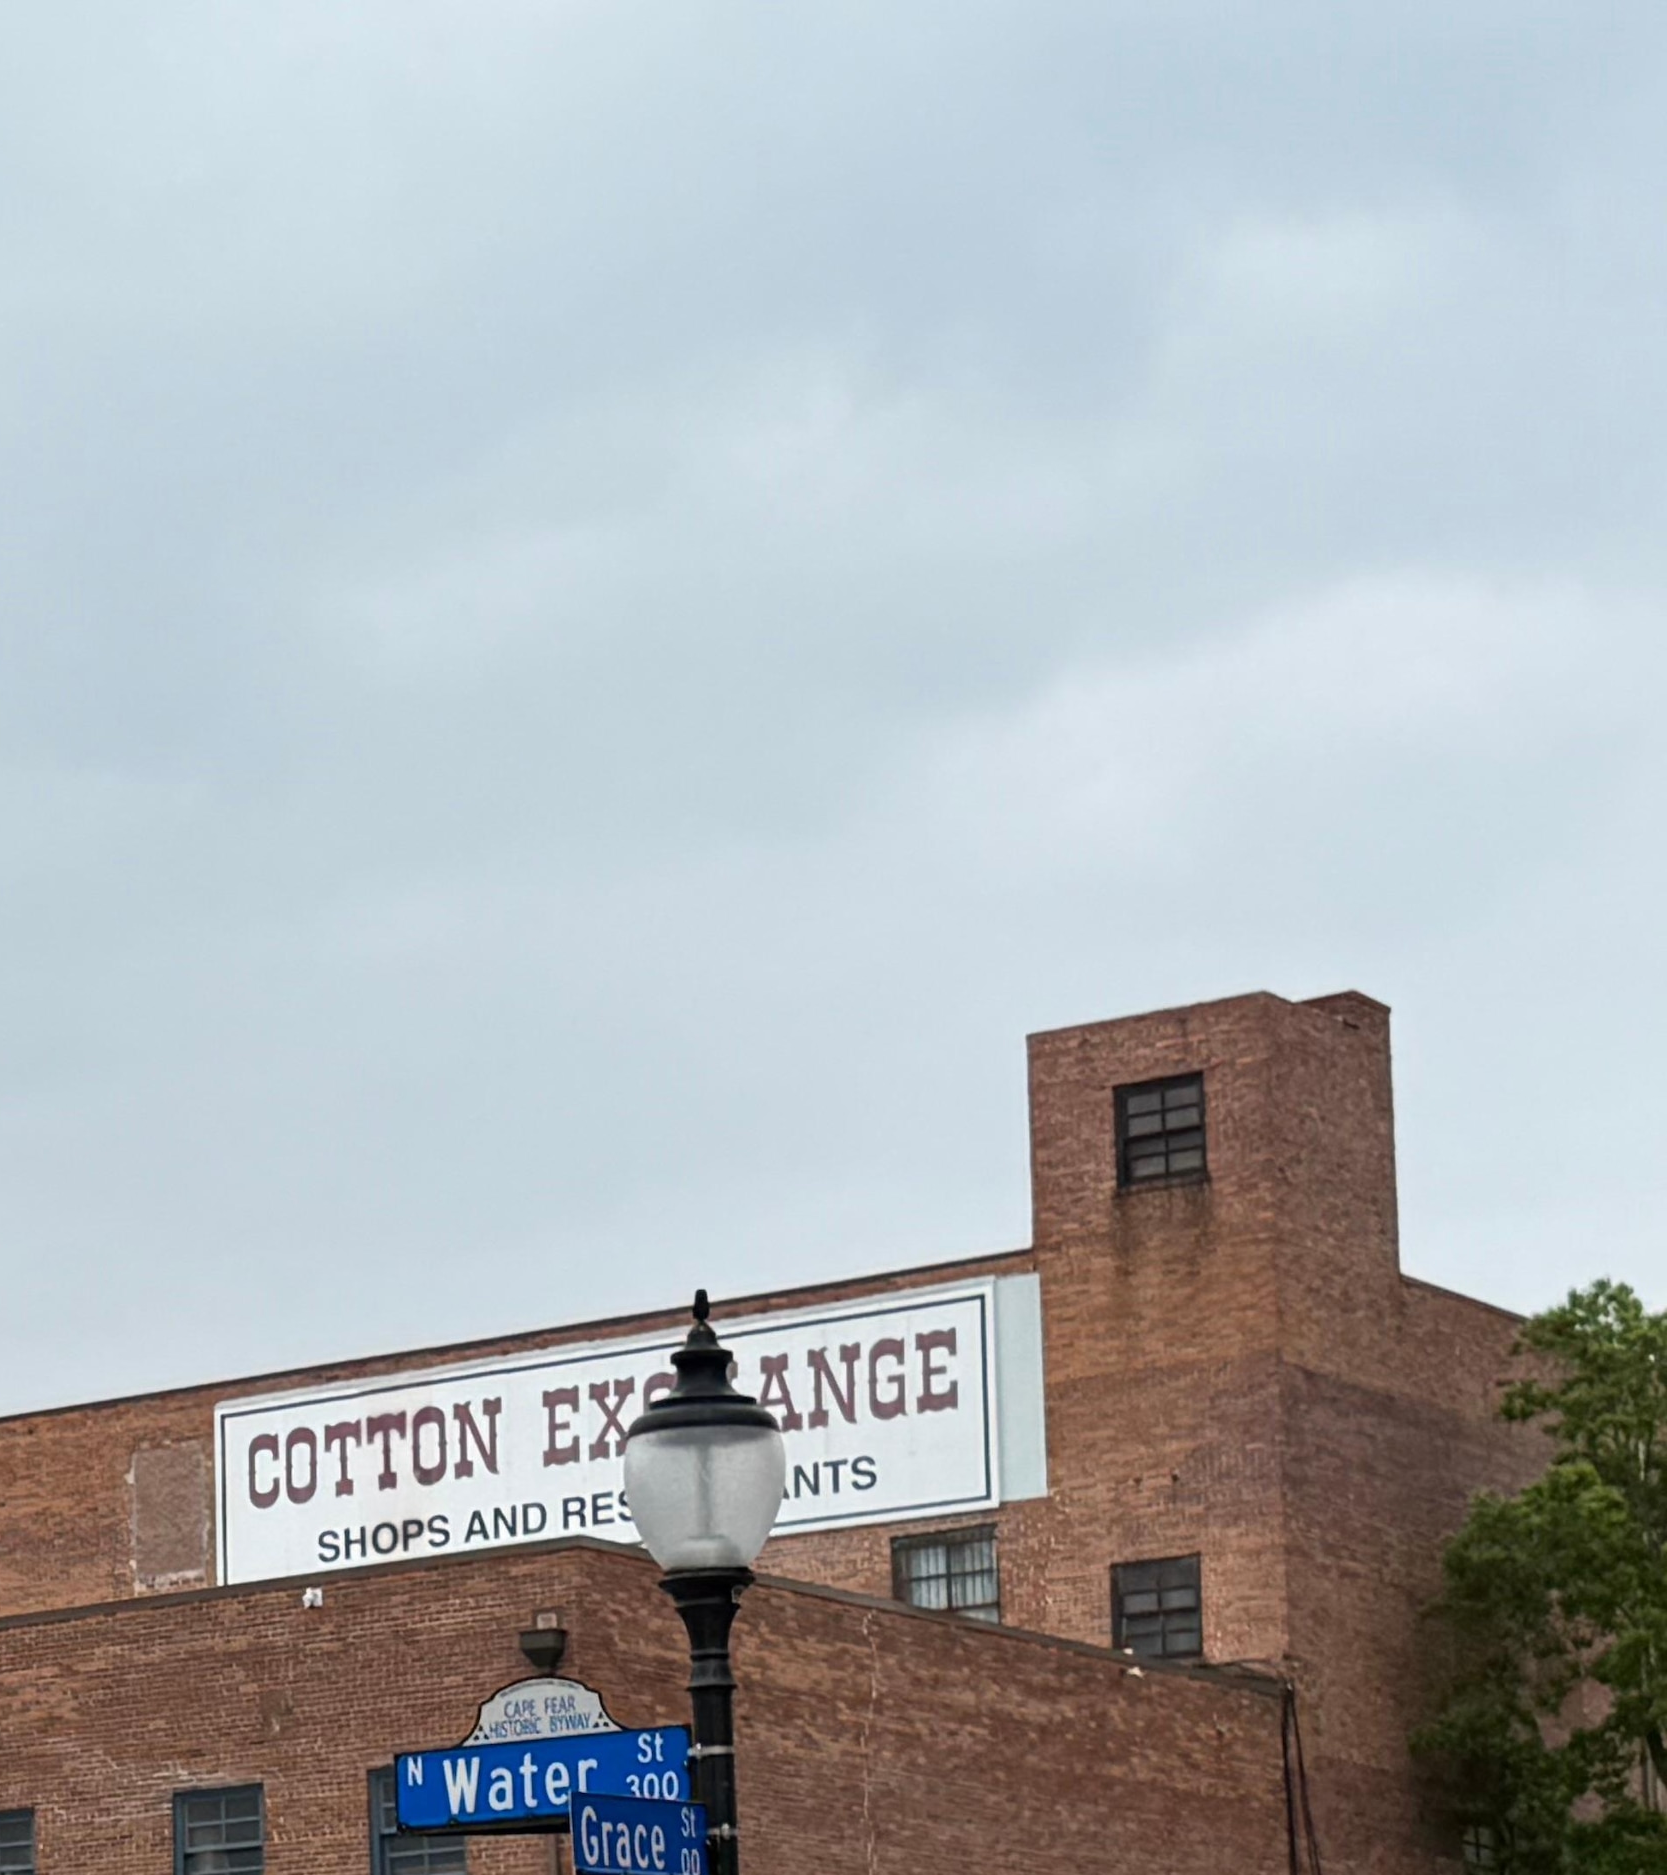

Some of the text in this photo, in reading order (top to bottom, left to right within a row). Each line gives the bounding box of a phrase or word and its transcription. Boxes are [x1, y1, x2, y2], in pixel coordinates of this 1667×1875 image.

[248, 1327, 959, 1509] COTTON EXANGE
[317, 1456, 878, 1563] SHOPS AND RESNTS
[488, 1712, 592, 1739] HISTORIC BYWAY
[503, 1695, 577, 1719] CAPE FEAR
[407, 1733, 664, 1816] N Water St
[626, 1771, 679, 1800] 300
[581, 1805, 697, 1870] Grace St
